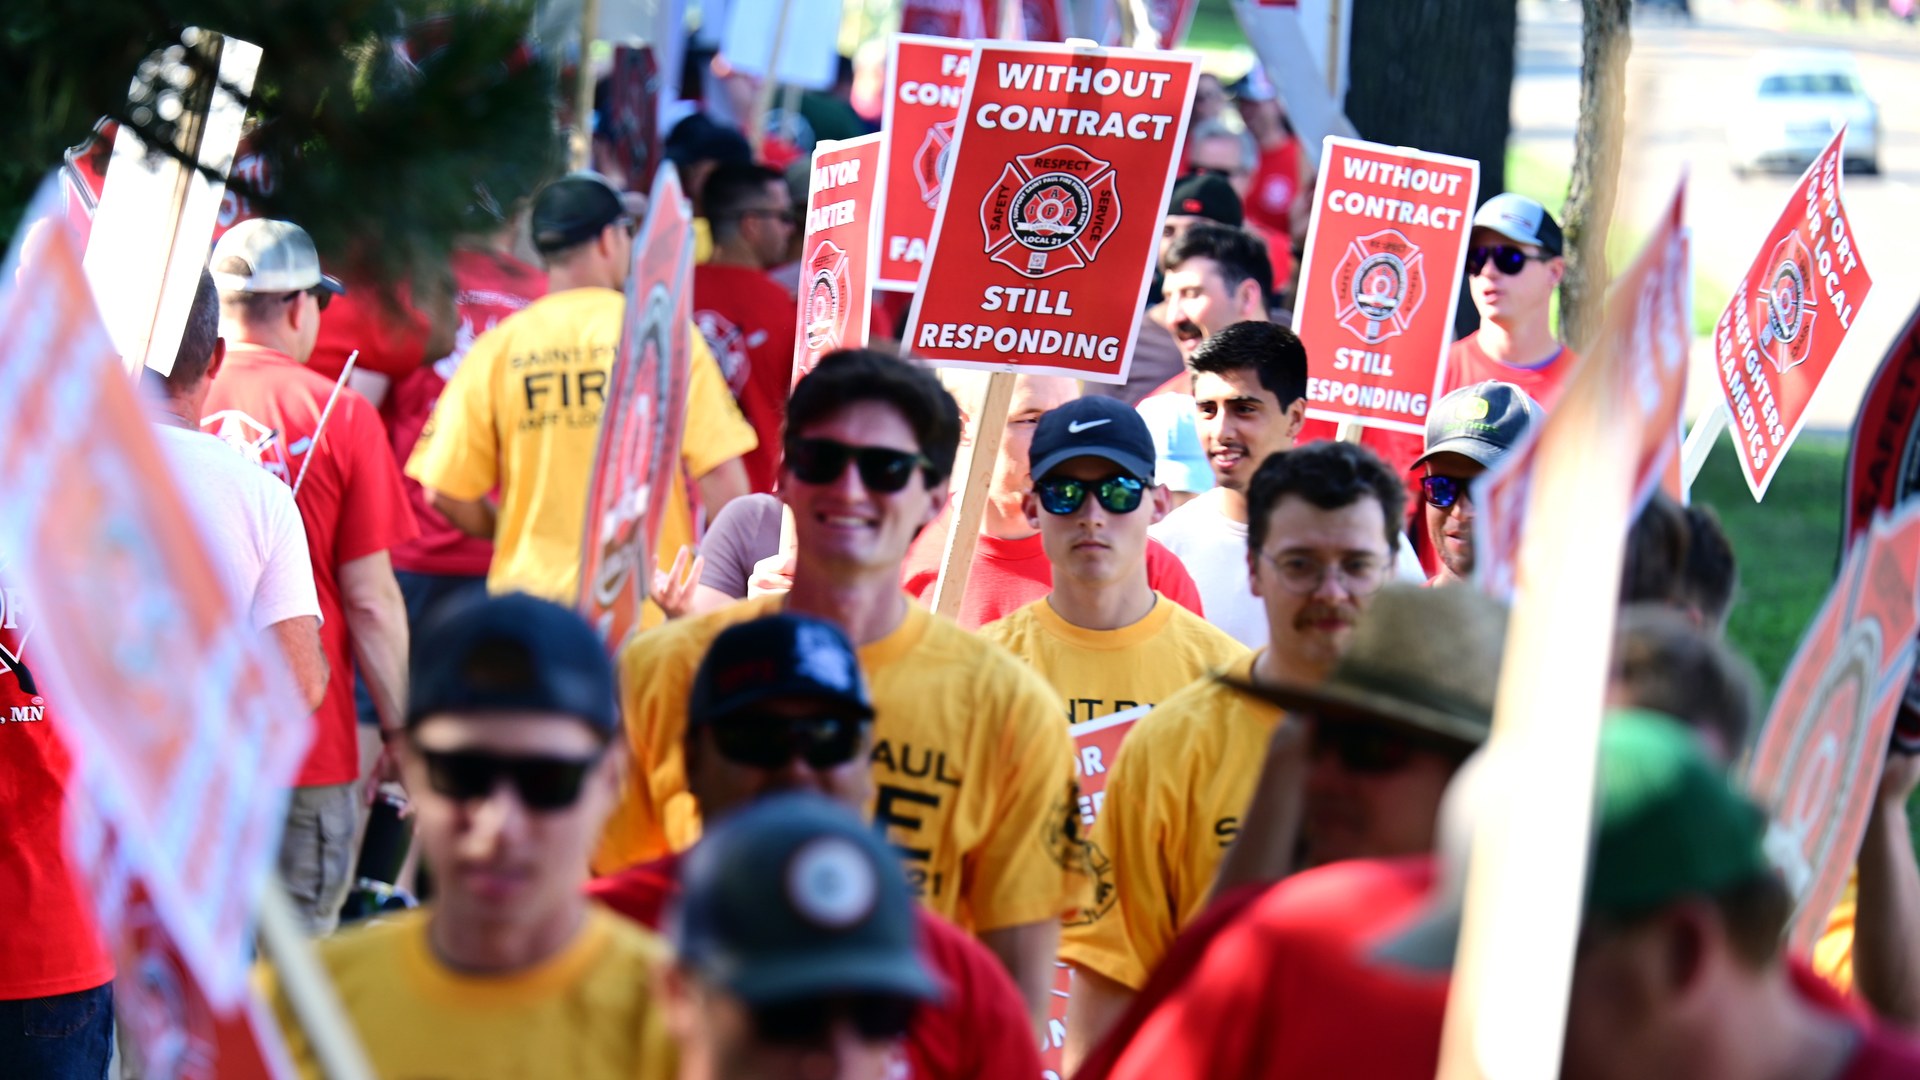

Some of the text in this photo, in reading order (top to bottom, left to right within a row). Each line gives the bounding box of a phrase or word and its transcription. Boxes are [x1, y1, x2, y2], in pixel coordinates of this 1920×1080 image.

[941, 54, 971, 77] FA
[997, 62, 1171, 99] WITHOUT
[976, 103, 1172, 141] CONTRACT
[1034, 158, 1091, 171] RESPECT
[1344, 156, 1462, 196] WITHOUT
[990, 185, 1010, 231] SAFETY
[1012, 193, 1027, 219] SUPPORT
[1025, 180, 1042, 194] SAINT
[1059, 177, 1073, 185] FIRE
[1090, 189, 1112, 241] SERVICE
[1328, 189, 1462, 230] CONTRACT
[1822, 150, 1857, 275] SUPPORT
[1023, 236, 1050, 244] LOCAL
[1806, 158, 1852, 330] YOUR LOCAL
[981, 286, 1073, 317] STILL
[918, 323, 1120, 362] RESPONDING
[1333, 347, 1394, 377] STILL
[1734, 279, 1785, 447] FIREFIGHTERS
[525, 369, 607, 410] FIR
[1306, 377, 1427, 417] ESPONDING
[1718, 308, 1768, 470] PARAMEDICS
[10, 706, 45, 722] MN
[869, 739, 961, 788] AUL
